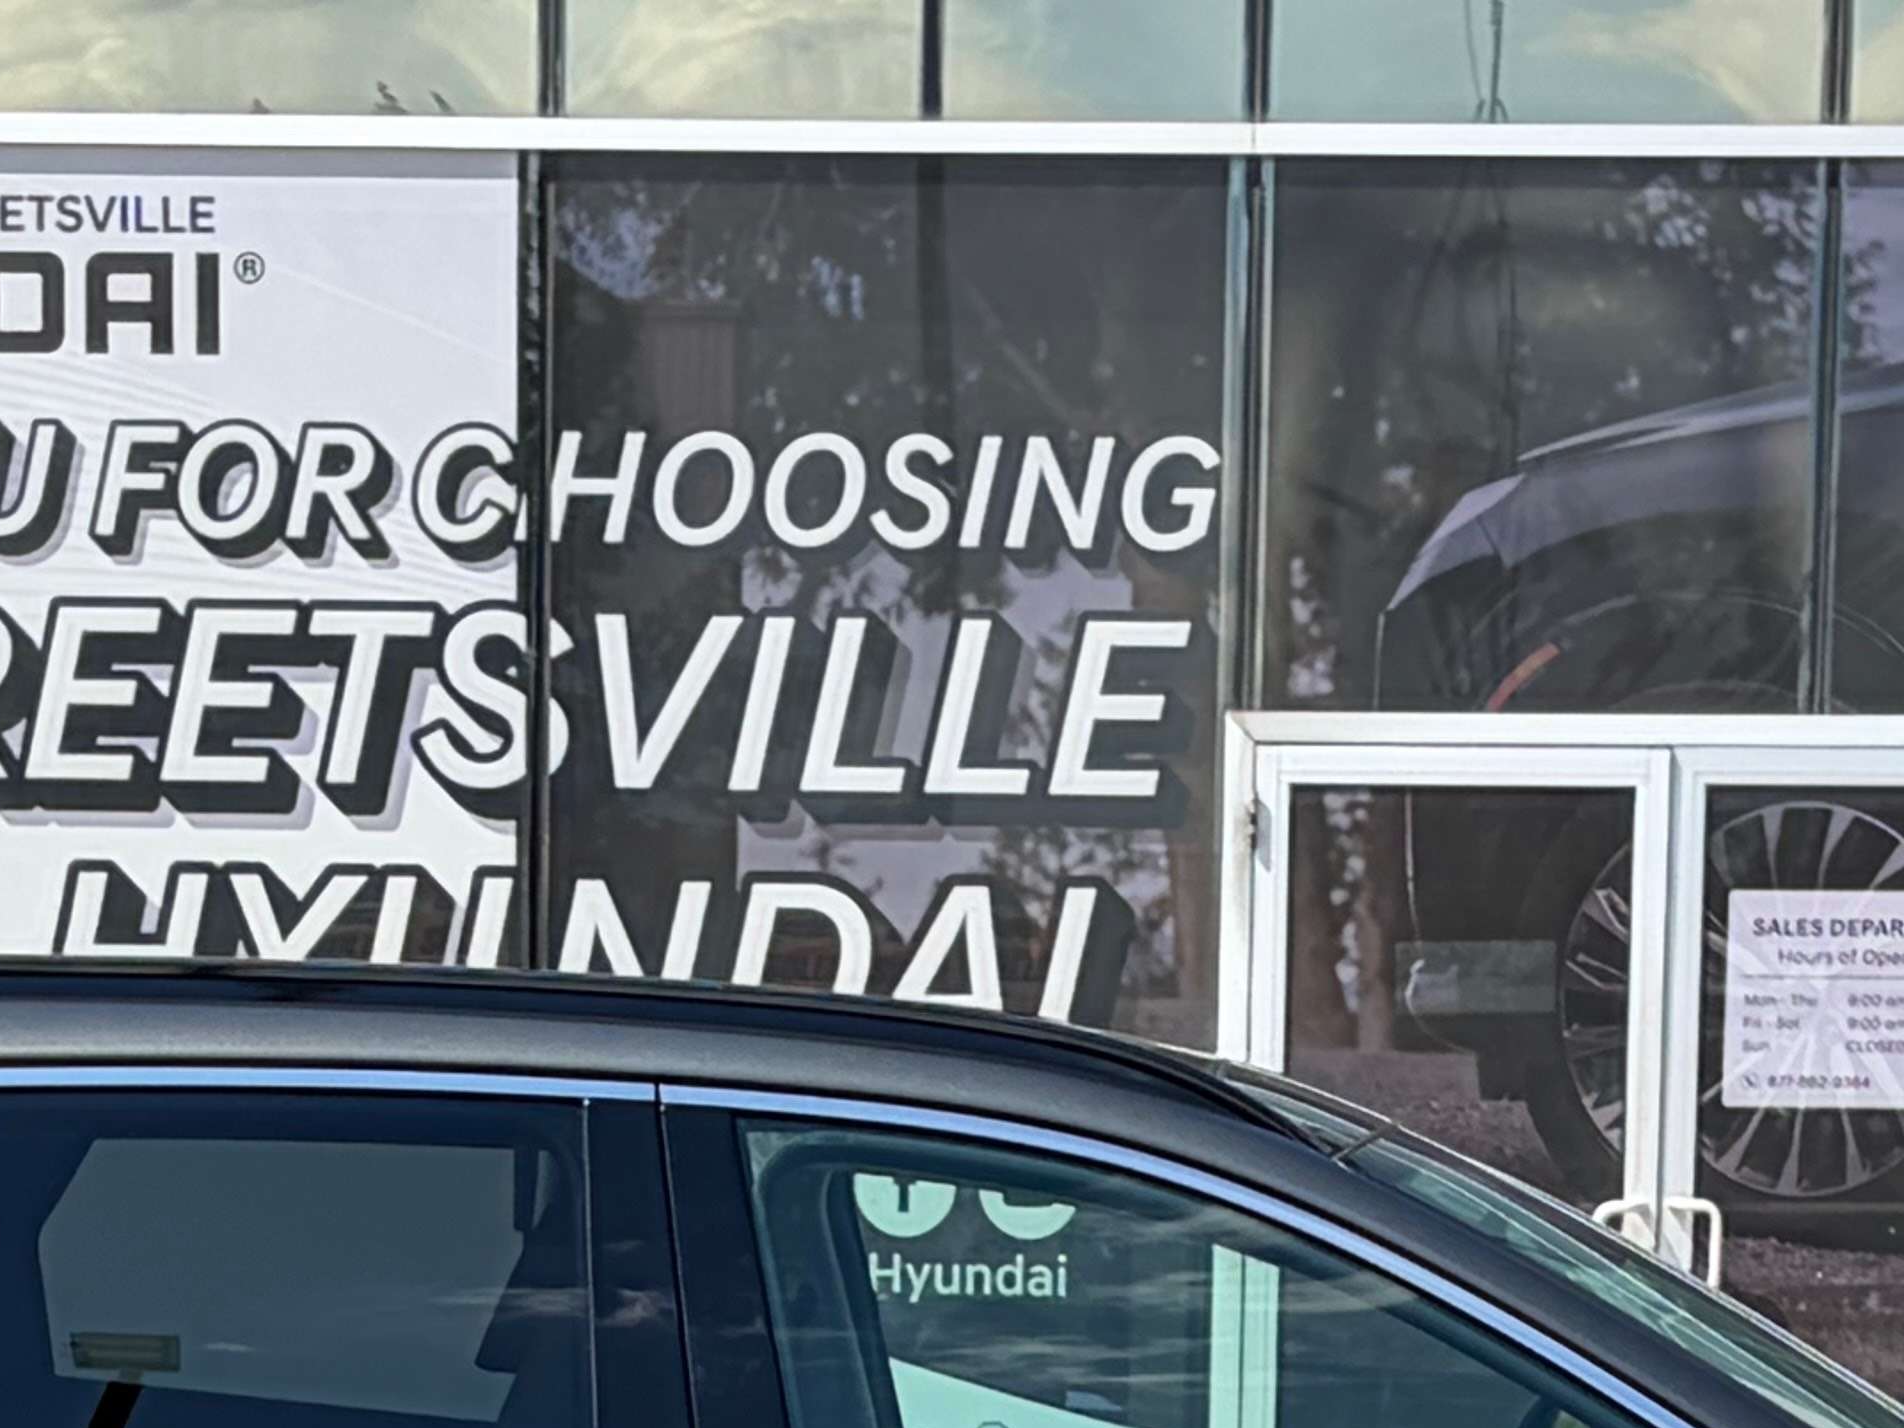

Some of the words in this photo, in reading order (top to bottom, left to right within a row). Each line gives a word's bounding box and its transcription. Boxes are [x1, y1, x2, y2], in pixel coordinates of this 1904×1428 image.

[90, 417, 393, 564] FOR
[410, 420, 1223, 562] CHOOSING
[1753, 917, 1823, 938] SALES
[1777, 949, 1833, 966] Hours
[1839, 948, 1858, 966] of
[868, 1251, 1068, 1304] Hyundai
